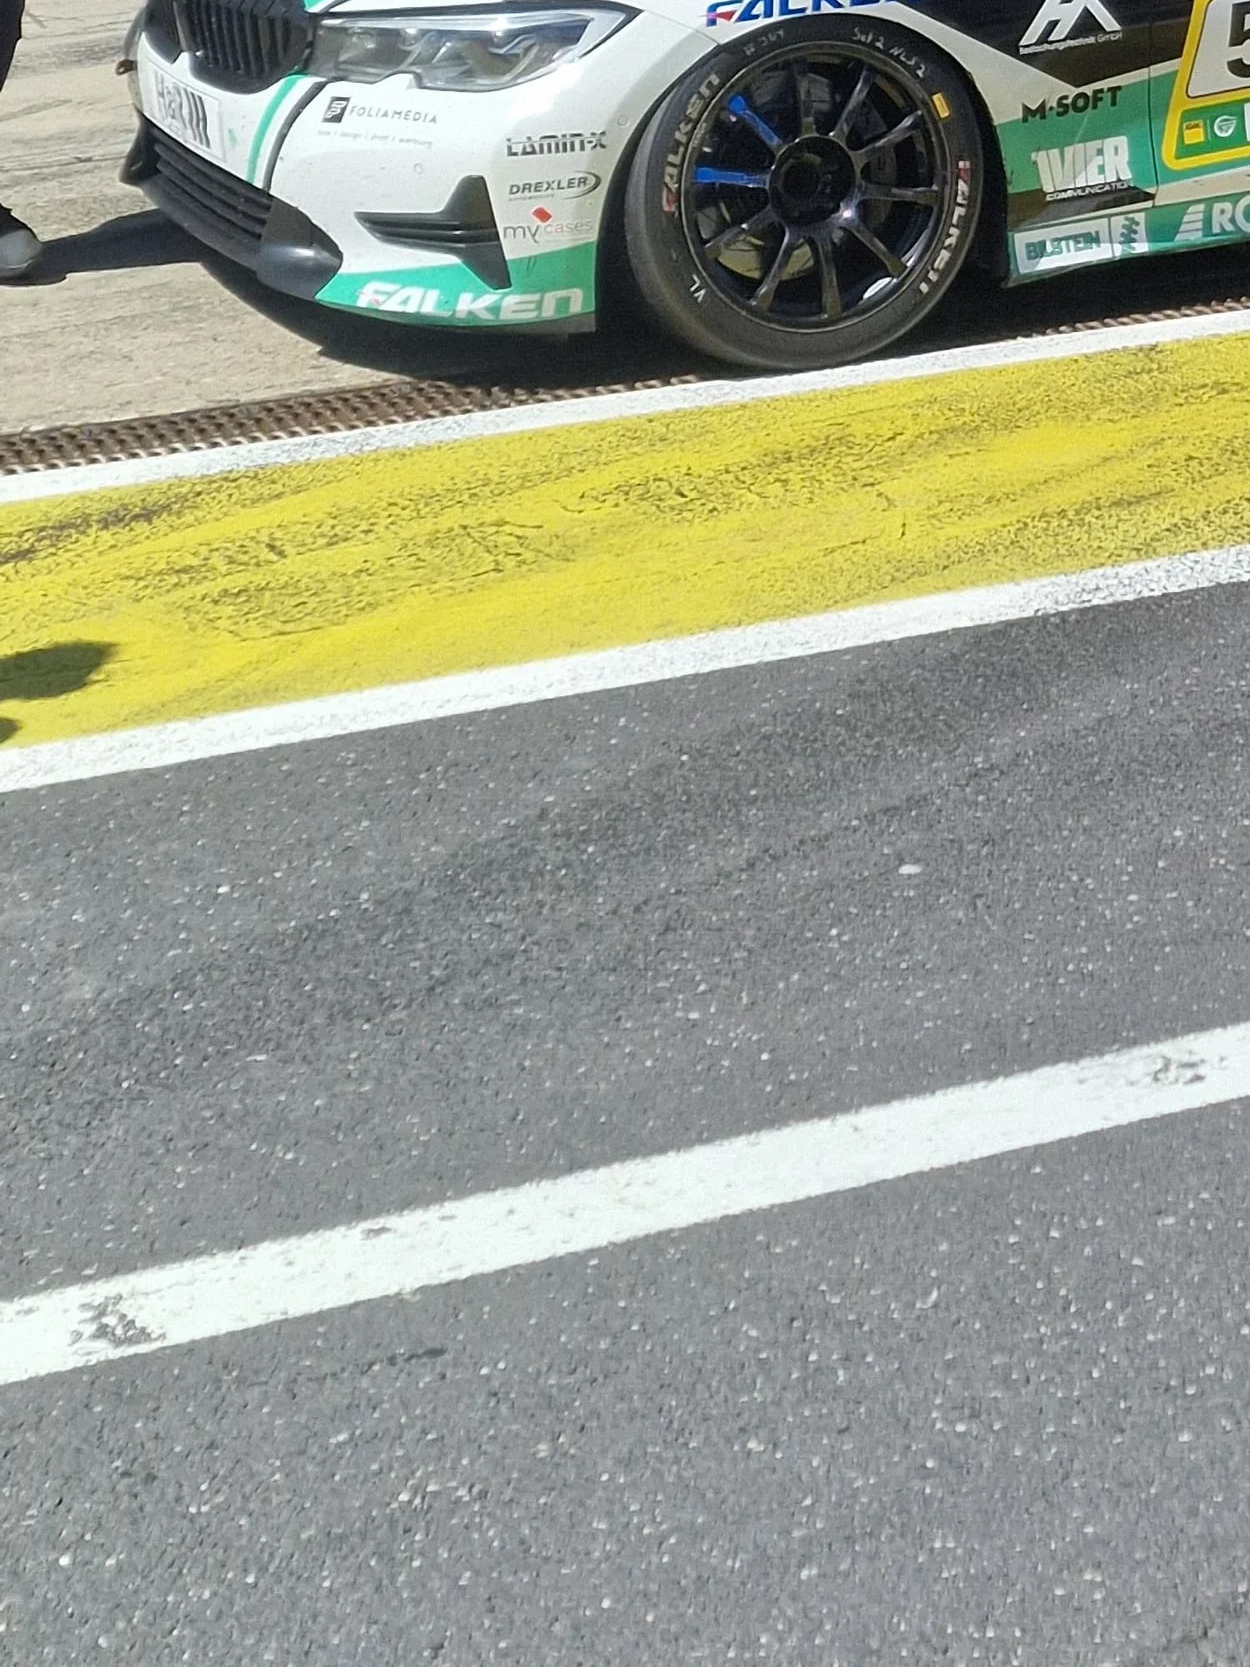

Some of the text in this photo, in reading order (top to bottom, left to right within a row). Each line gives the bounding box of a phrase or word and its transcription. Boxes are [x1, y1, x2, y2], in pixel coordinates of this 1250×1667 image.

[349, 104, 438, 124] FOLIAMEDIA
[508, 175, 589, 196] DREXLER
[1025, 230, 1102, 262] BILSTEIN
[356, 281, 584, 321] FALKEN
